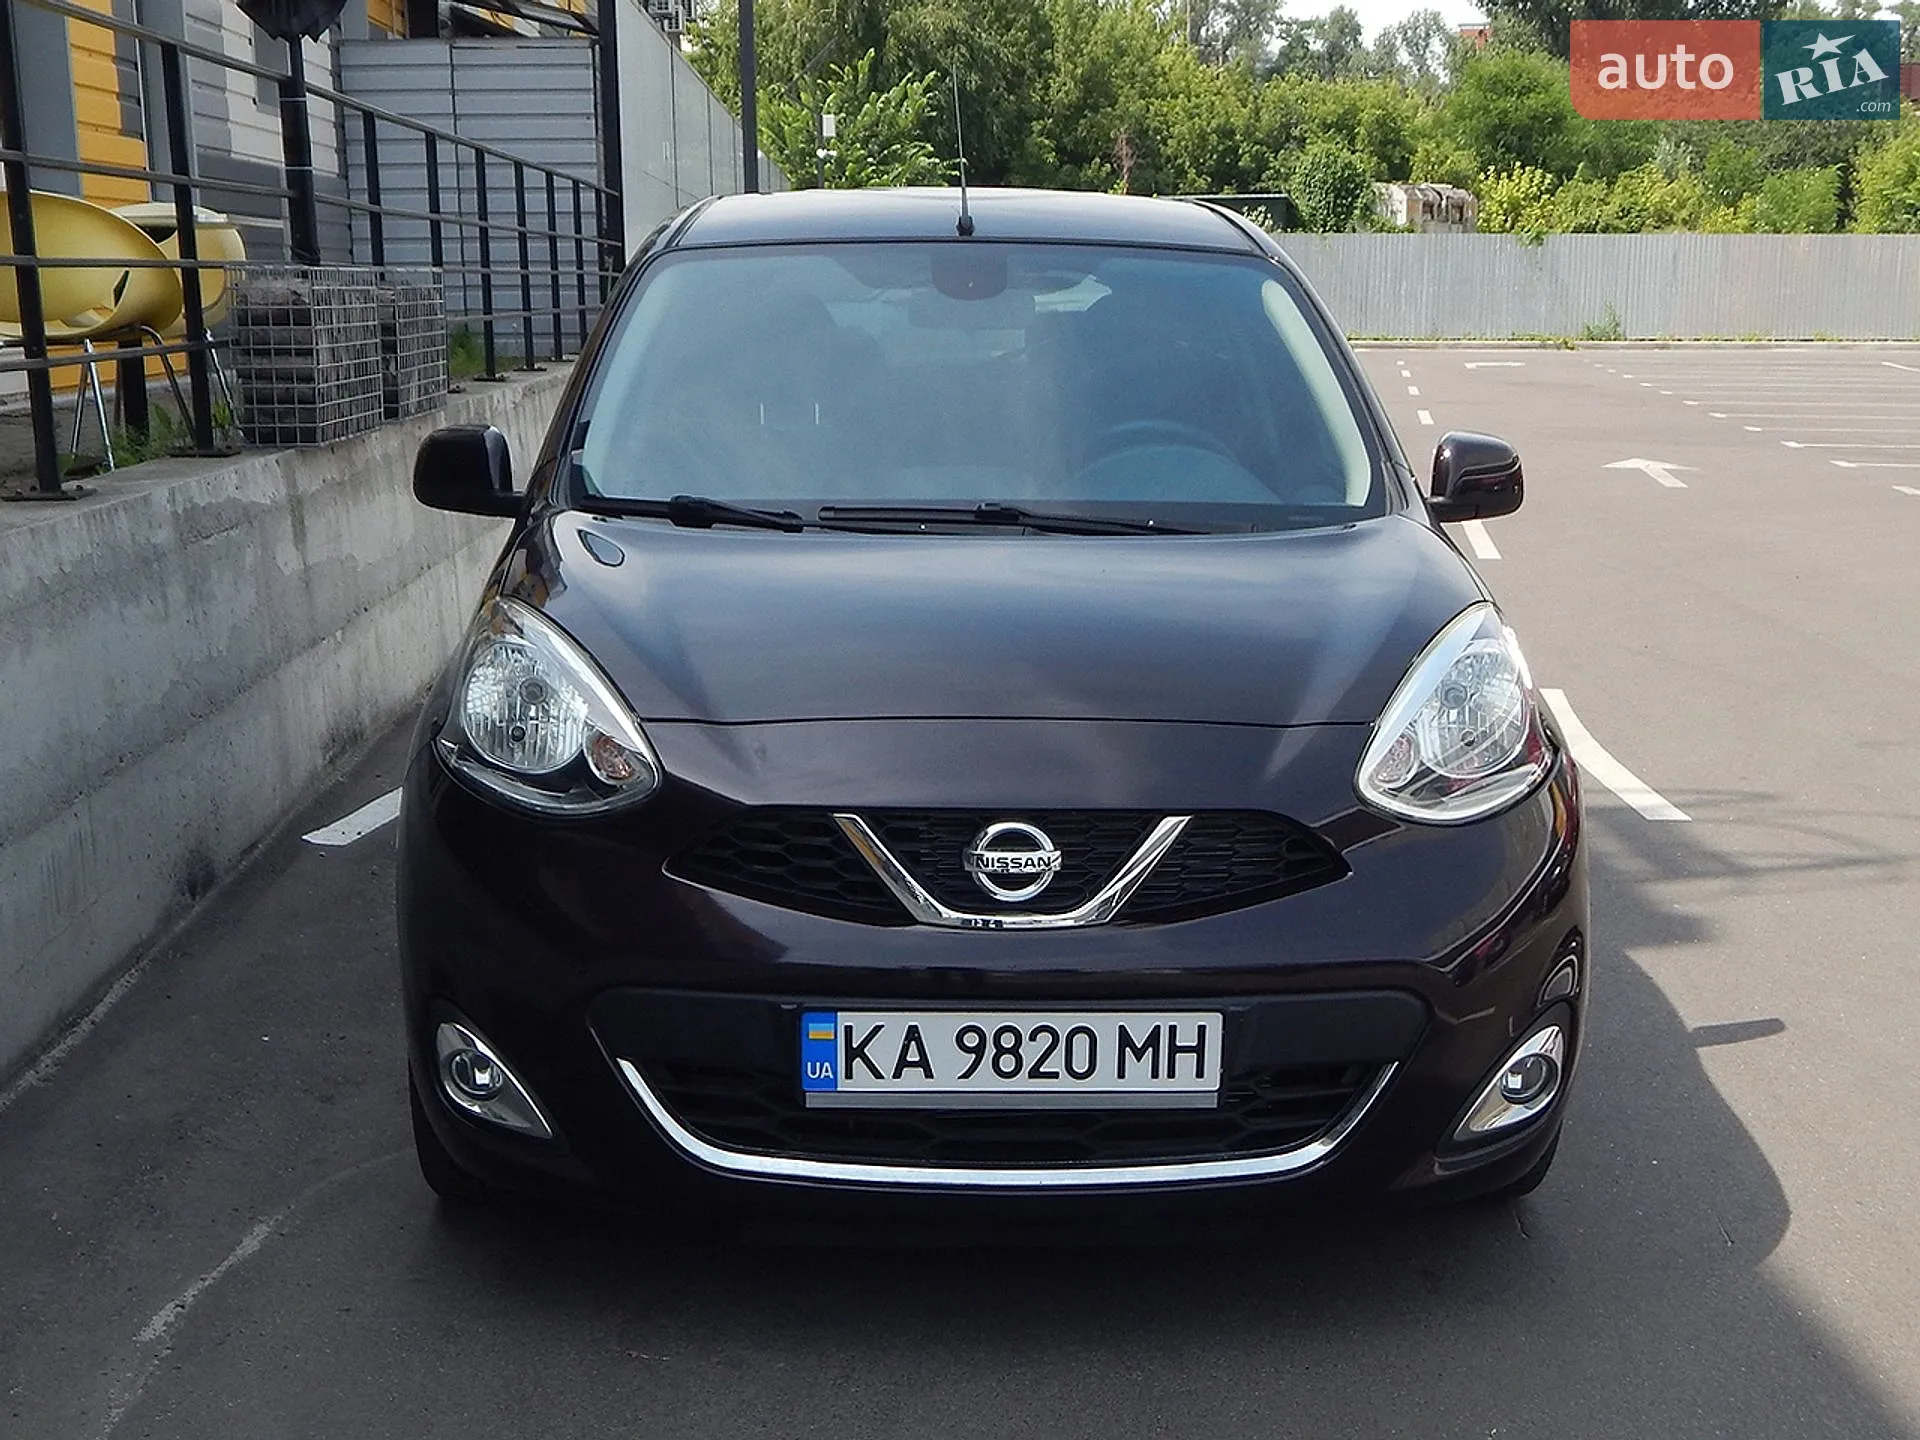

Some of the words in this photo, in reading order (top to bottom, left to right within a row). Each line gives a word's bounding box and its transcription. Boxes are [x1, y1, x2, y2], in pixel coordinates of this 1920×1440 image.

[975, 856, 1051, 870] NISSAN
[843, 1023, 934, 1080] KA
[955, 1023, 1098, 1081] 9820
[1116, 1023, 1208, 1080] MH
[807, 1062, 834, 1079] UA
